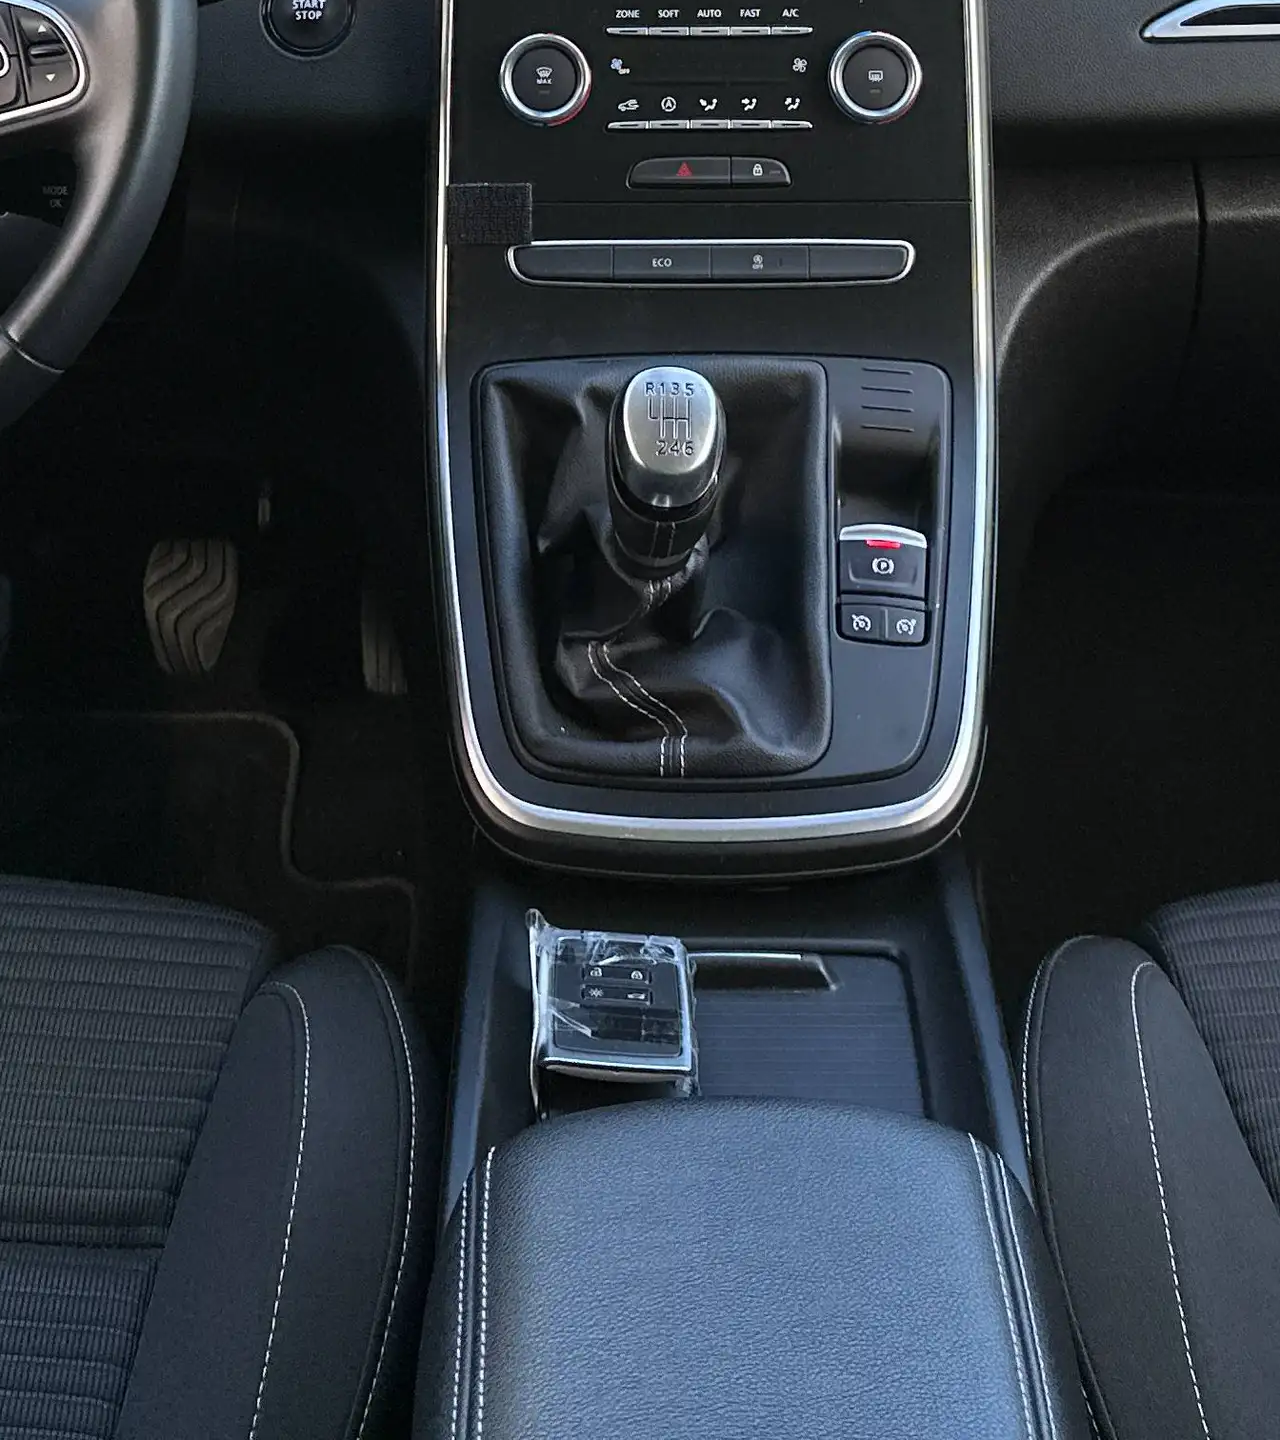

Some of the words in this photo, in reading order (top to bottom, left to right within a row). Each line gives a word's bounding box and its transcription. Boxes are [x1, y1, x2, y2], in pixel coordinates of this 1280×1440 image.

[292, 0, 326, 10] START
[295, 10, 323, 21] STOP
[615, 9, 640, 19] ZONE
[657, 9, 680, 19] SOFT
[697, 8, 722, 18] AUTO
[740, 8, 761, 18] FAST
[782, 8, 800, 18] A/C
[651, 257, 673, 268] ECO
